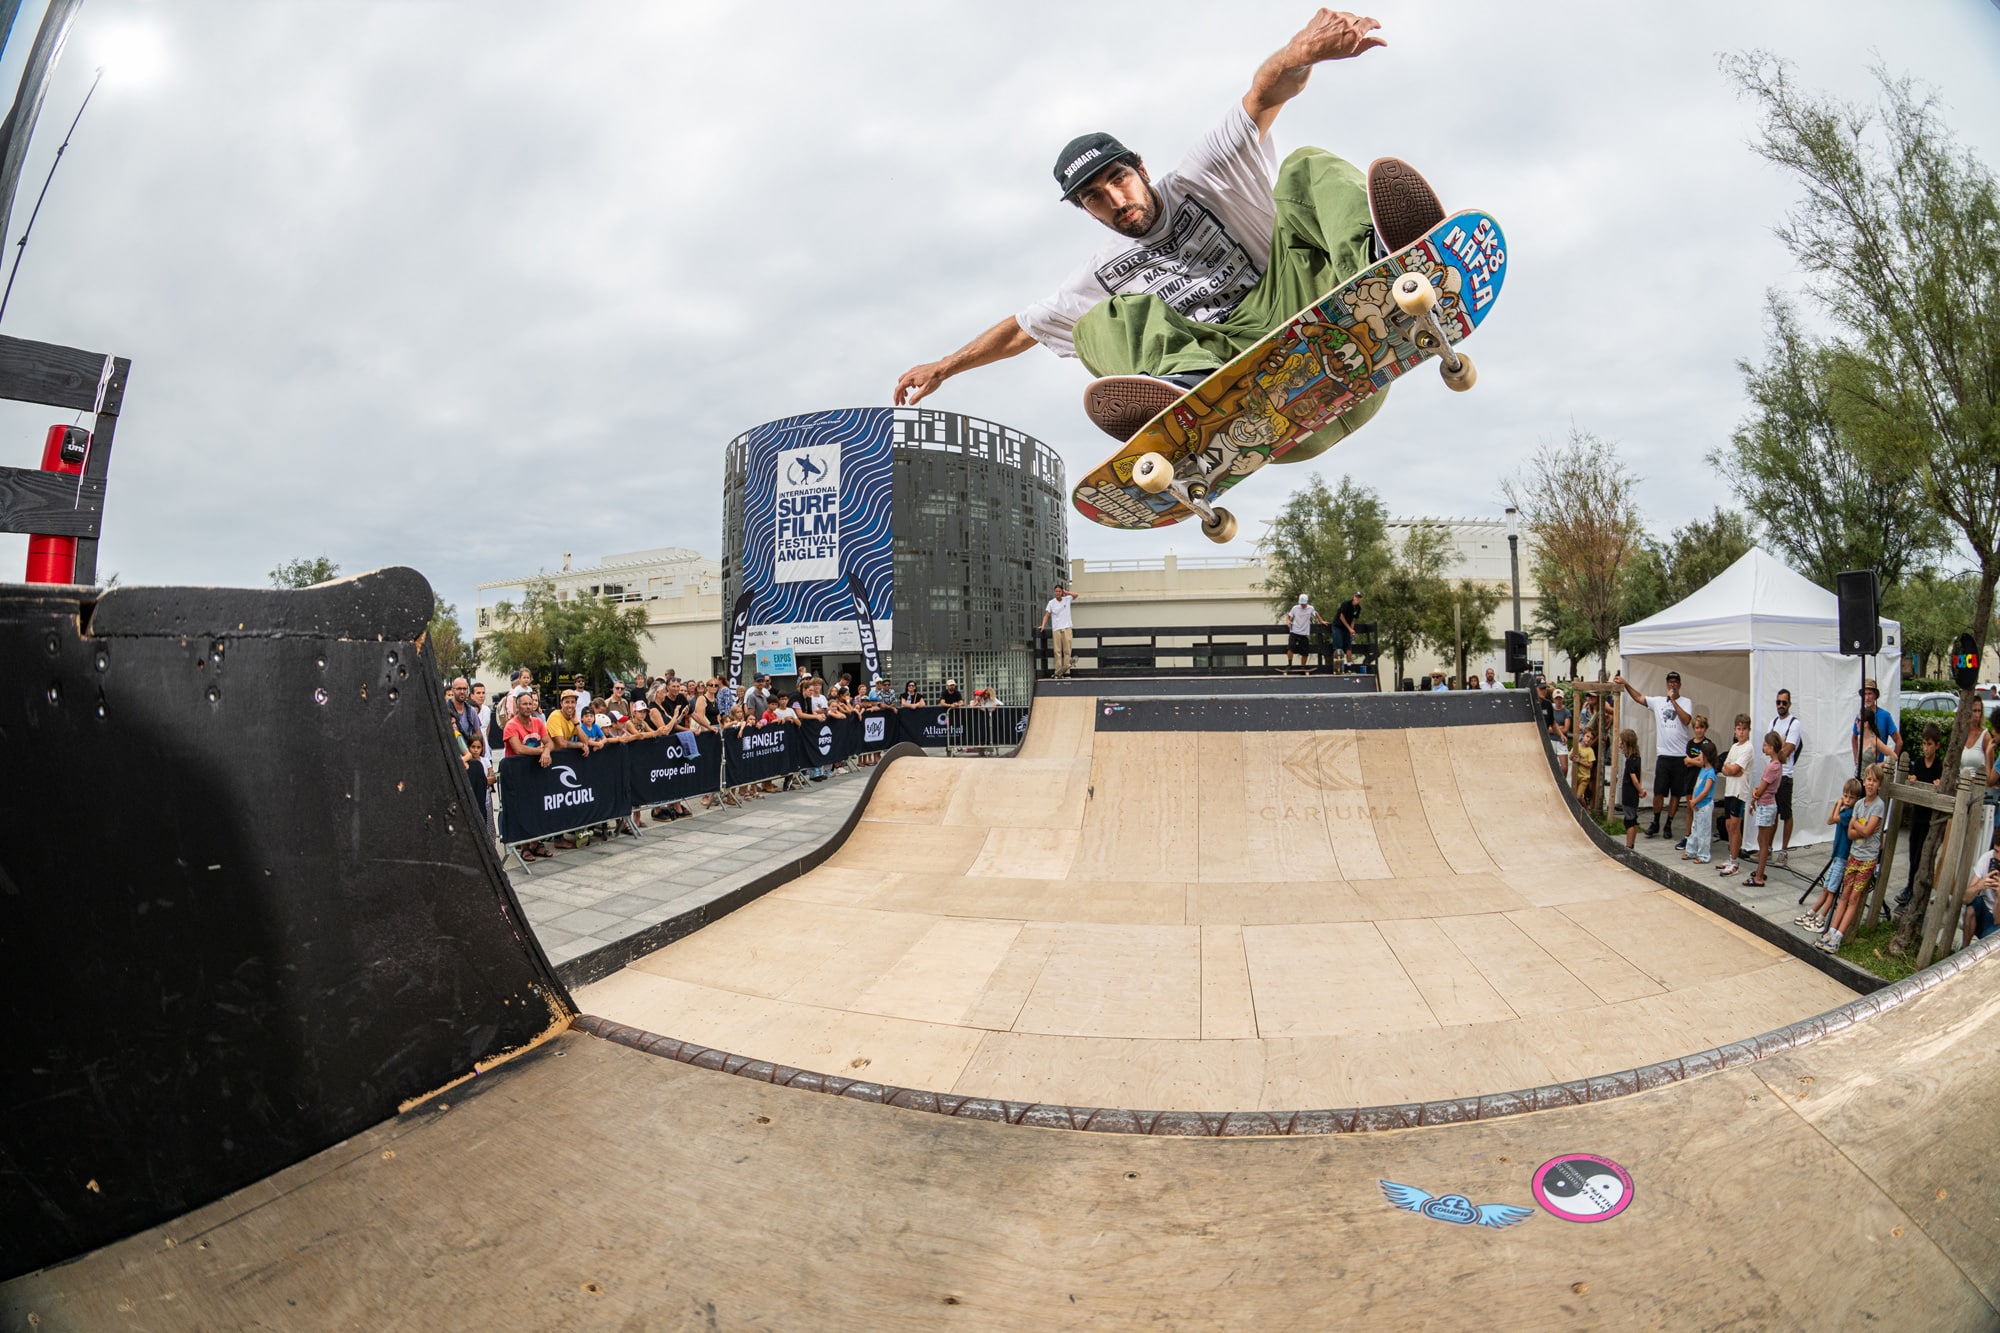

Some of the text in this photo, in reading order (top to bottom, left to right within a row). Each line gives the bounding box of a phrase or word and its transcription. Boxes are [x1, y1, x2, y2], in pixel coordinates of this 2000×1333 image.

[1064, 148, 1102, 178] SK8MAFIA
[1115, 254, 1144, 275] DR.
[1442, 225, 1494, 312] MAFIA
[1143, 266, 1168, 284] NAS
[1209, 263, 1236, 289] CLAN
[779, 486, 837, 498] INTERNATIONAL
[778, 493, 837, 518] SURF
[1089, 492, 1140, 528] TURNER
[778, 513, 837, 539] FILM
[778, 535, 836, 550] FESTIVAL
[778, 546, 836, 562] ANGLET
[793, 635, 824, 645] ANGLET
[773, 653, 791, 663] EXPOS
[923, 724, 963, 735] Atlanhal
[752, 730, 784, 749] ANGLET
[818, 737, 832, 745] PEPSI
[650, 763, 696, 782] groupe clim
